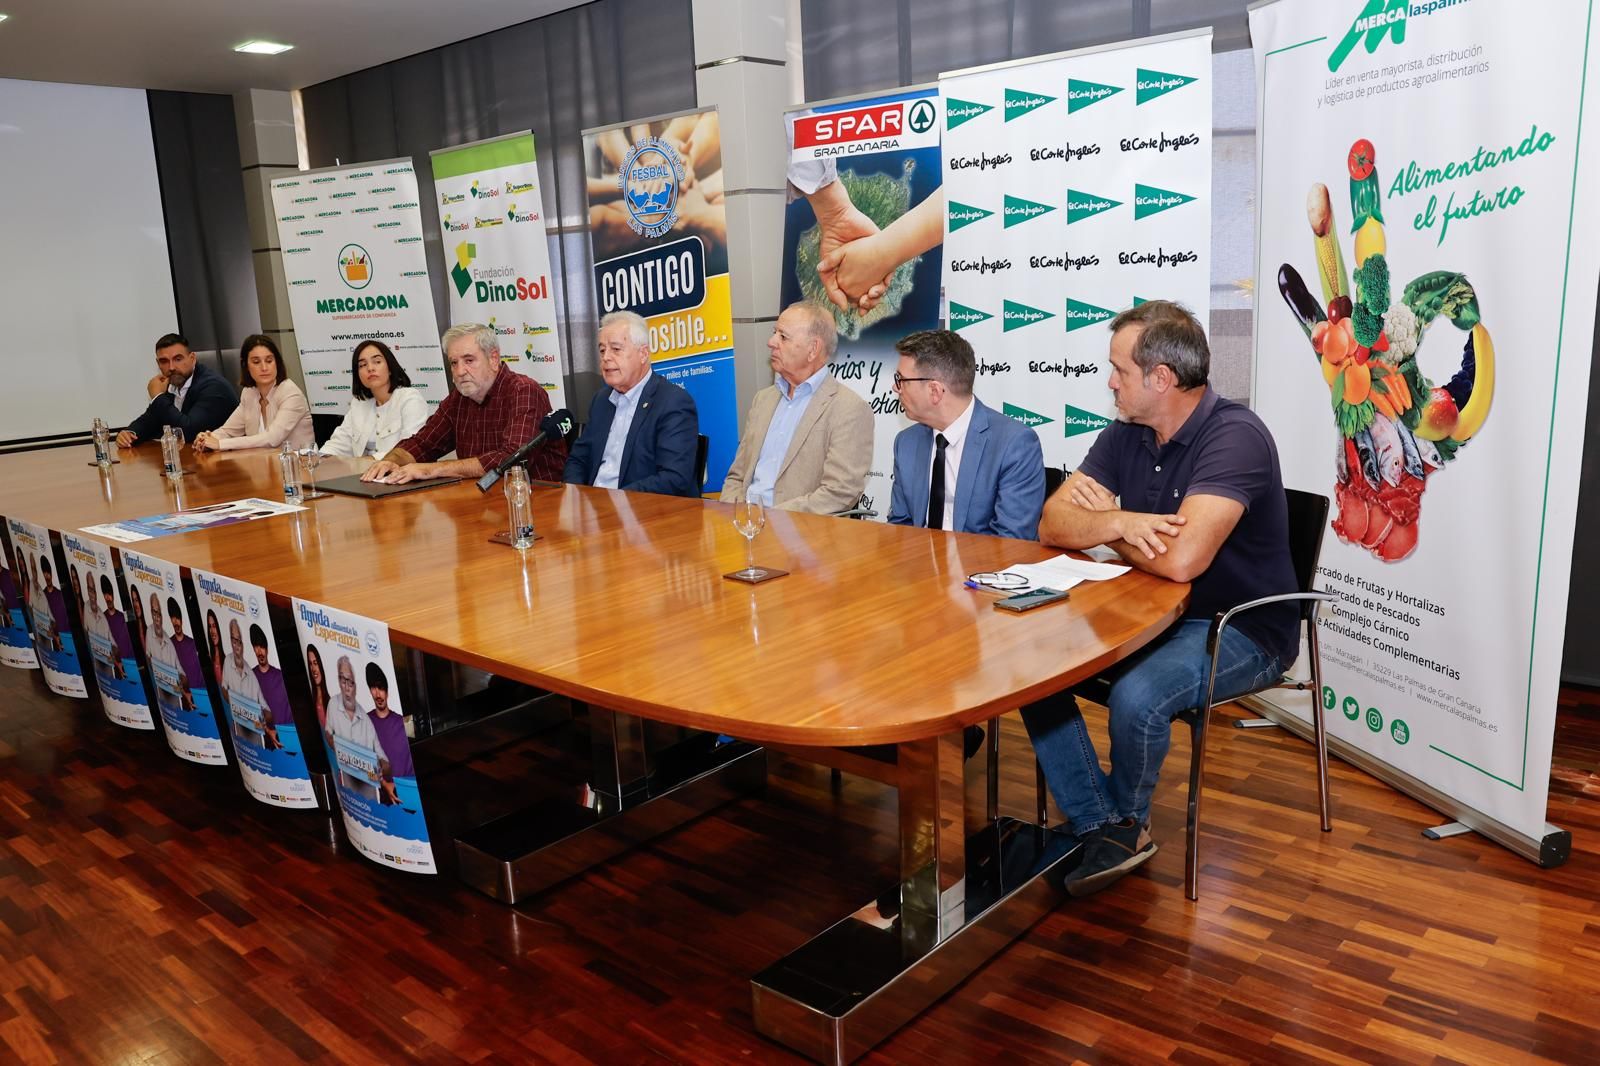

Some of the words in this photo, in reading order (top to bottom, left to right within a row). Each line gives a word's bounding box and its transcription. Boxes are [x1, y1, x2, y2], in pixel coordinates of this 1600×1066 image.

[1355, 8, 1406, 32] MERCA
[1325, 75, 1344, 90] Líder
[1346, 76, 1356, 86] en
[1357, 70, 1379, 82] venta
[1381, 60, 1424, 79] mayorista,
[1427, 44, 1483, 66] distribución
[1069, 90, 1075, 99] El
[1075, 90, 1089, 98] Corte
[1090, 87, 1112, 99] Inglés
[1138, 81, 1145, 90] El
[1145, 80, 1160, 88] Corte
[1160, 77, 1184, 90] Inglés
[1316, 98, 1322, 108] y
[1324, 90, 1354, 106] logística
[1356, 87, 1365, 98] de
[1366, 80, 1410, 98] productos
[1412, 61, 1490, 88] agroalimentarios
[965, 105, 983, 117] Inglés
[1006, 100, 1012, 108] El
[1012, 99, 1025, 107] Corte
[1025, 96, 1045, 108] Inglés
[815, 110, 900, 140] SPAR
[1120, 138, 1131, 152] El
[1132, 138, 1158, 150] Corte
[1159, 132, 1199, 152] Inglés
[950, 158, 958, 170] El
[959, 158, 979, 168] Corte
[980, 152, 1012, 170] Inglés
[1030, 148, 1040, 161] El
[1040, 148, 1064, 160] Corte
[1065, 142, 1100, 162] Inglés
[1388, 124, 1556, 200] Alimentando
[632, 165, 670, 182] FESBAL
[1005, 206, 1011, 215] El
[1011, 206, 1025, 214] Corte
[1025, 204, 1045, 216] Inglés
[1068, 202, 1075, 210] El
[1075, 202, 1089, 210] Corte
[1089, 200, 1111, 211] Inglés
[1136, 196, 1142, 205] El
[1142, 196, 1158, 205] Corte
[1158, 194, 1182, 207] Inglés
[966, 209, 984, 220] Inglés
[1414, 195, 1438, 230] el
[1437, 186, 1526, 248] futuro
[952, 260, 959, 272] El
[960, 260, 979, 271] Corte
[980, 256, 1011, 274] Inglés
[1030, 256, 1039, 268] El
[1040, 256, 1063, 268] Corte
[1064, 252, 1099, 271] Inglés
[1119, 252, 1130, 264] El
[1130, 252, 1156, 264] Corte
[1157, 247, 1198, 268] Inglés
[474, 265, 515, 280] Fundación
[602, 250, 694, 312] CONTIGO
[475, 276, 548, 303] DinoSol
[316, 294, 408, 314] MERCADONA
[966, 311, 983, 322] Inglés
[1024, 310, 1044, 321] Inglés
[1067, 310, 1073, 318] El
[1073, 310, 1087, 318] Corte
[1088, 308, 1110, 320] Inglés
[331, 330, 405, 340] www.mercadona.es
[666, 370, 681, 380] miles
[682, 369, 690, 377] de
[980, 358, 1011, 376] Inglés
[1029, 361, 1038, 373] El
[1039, 361, 1062, 373] Corte
[1063, 358, 1098, 377] Inglés
[870, 361, 882, 394] y
[1024, 414, 1042, 424] Inglés
[1087, 416, 1108, 427] Inglés
[1315, 566, 1342, 581] ercado
[1344, 573, 1354, 585] de
[1356, 577, 1385, 596] Frutas
[1387, 590, 1394, 600] y
[1396, 590, 1446, 616] Hortalizas
[1325, 584, 1360, 606] Mercado
[1363, 598, 1374, 610] de
[1376, 603, 1421, 627] Pescados
[300, 604, 330, 628] Ayuda
[1332, 604, 1372, 628] Complejo
[1374, 620, 1410, 642] Cárnico
[314, 624, 360, 649] Esperanza
[1323, 616, 1371, 646] Actividades
[1373, 638, 1461, 681] Complementarias
[1373, 662, 1392, 676] 35229
[1392, 672, 1403, 681] Las
[1404, 675, 1426, 691] Palmas
[1428, 686, 1436, 694] de
[1437, 689, 1455, 703] Gran
[1456, 697, 1481, 714] Canaria
[1416, 692, 1498, 733] www.mercalaspalmas.es
